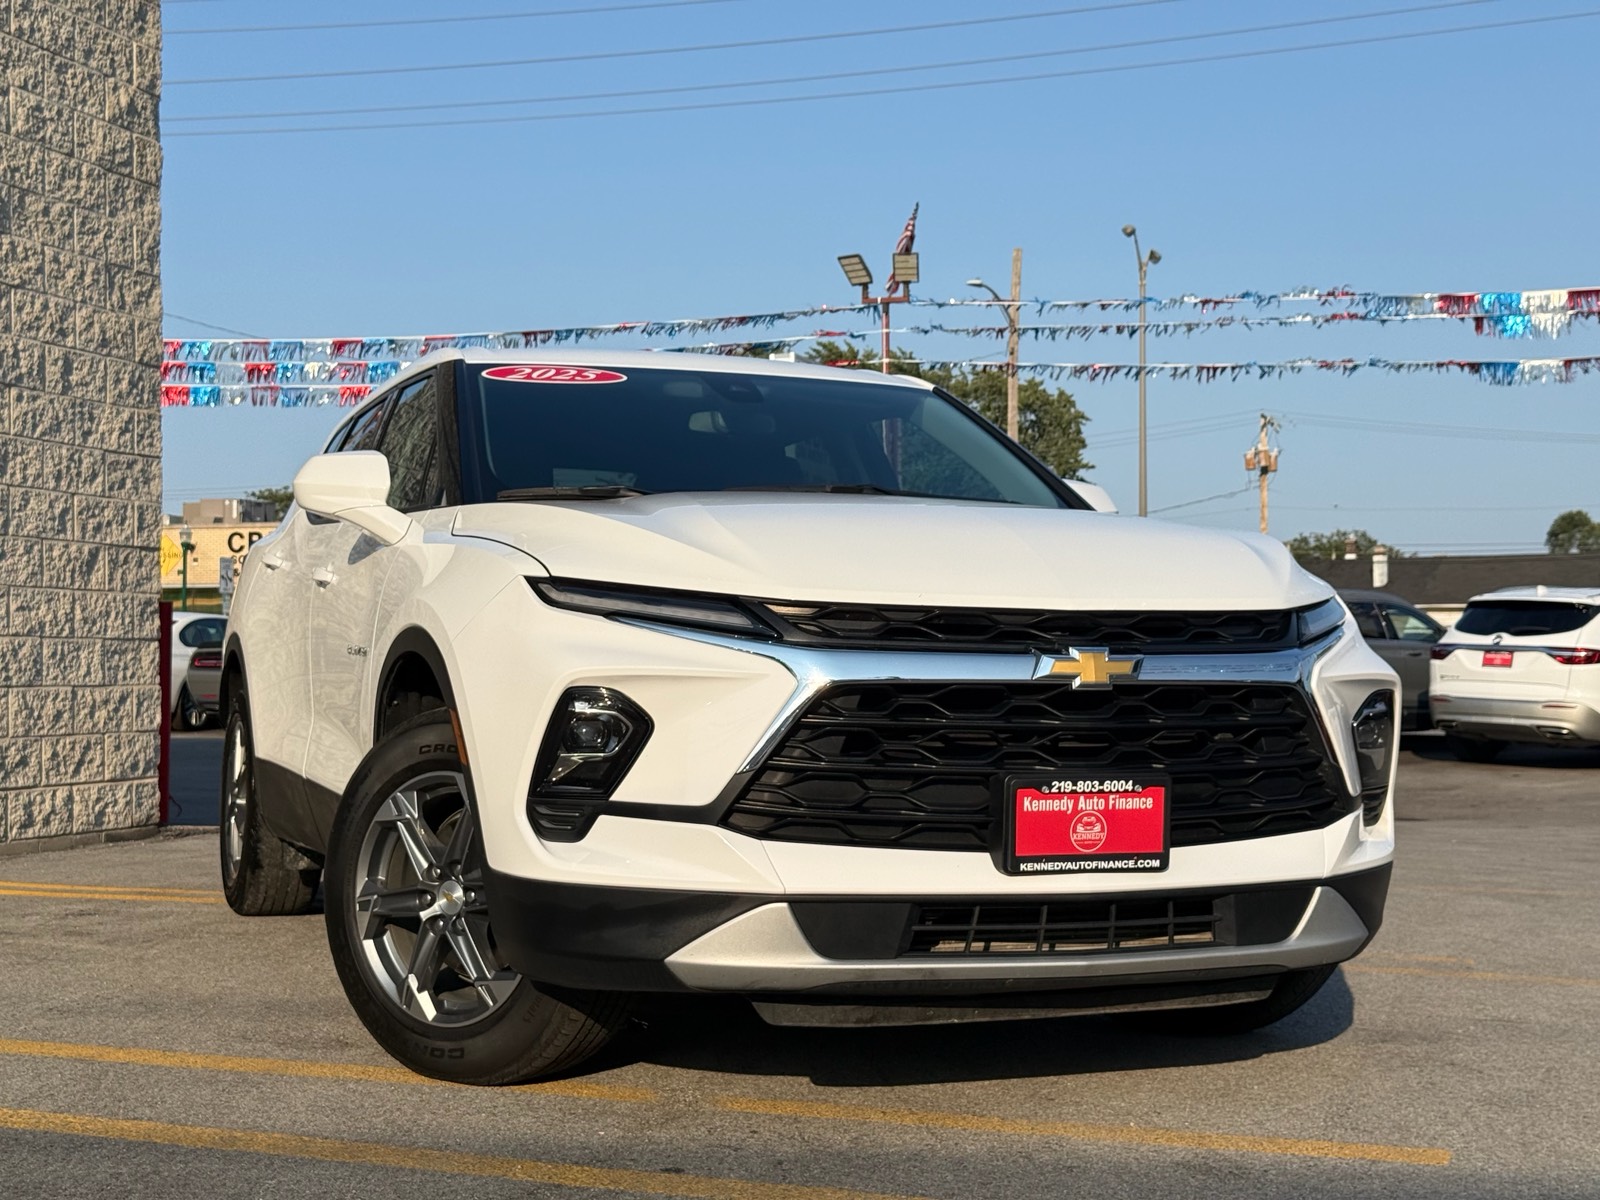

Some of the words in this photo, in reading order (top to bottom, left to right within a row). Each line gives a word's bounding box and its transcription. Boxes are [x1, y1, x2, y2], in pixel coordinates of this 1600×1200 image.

[505, 367, 602, 381] 2025
[1050, 780, 1134, 793] 219-803-6004
[1023, 796, 1075, 814] Kennedy
[1077, 795, 1105, 811] Auto
[1108, 794, 1154, 810] Finance
[1072, 832, 1105, 841] KENNEDY
[1019, 859, 1161, 871] KENNEDYAUTOFINANCE.COM
